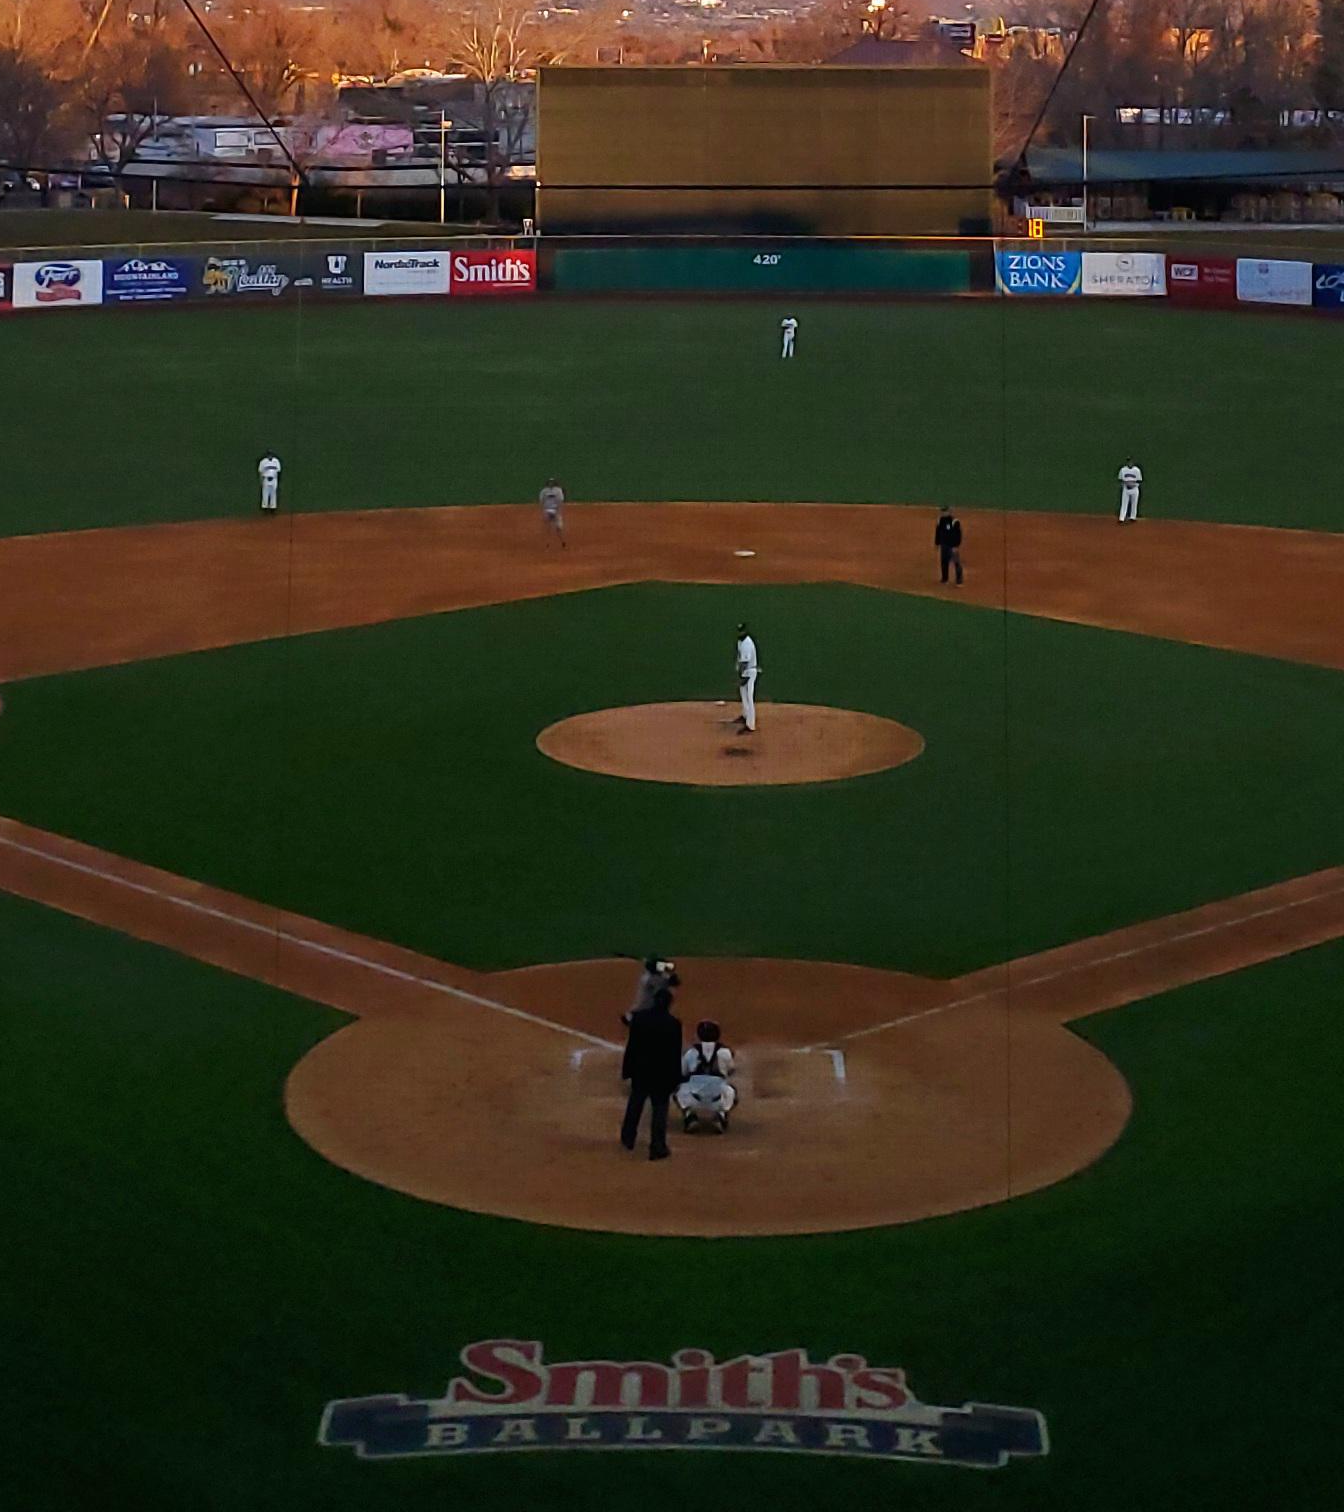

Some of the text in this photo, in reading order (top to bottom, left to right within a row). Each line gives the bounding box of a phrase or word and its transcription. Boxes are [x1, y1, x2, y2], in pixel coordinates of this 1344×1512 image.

[374, 259, 440, 270] NordicTrack
[453, 256, 531, 284] Smith's
[1008, 255, 1065, 273] ZIONS
[1008, 272, 1069, 289] BANK
[451, 1339, 912, 1411] Smith's
[425, 1414, 946, 1456] BALLPARK
